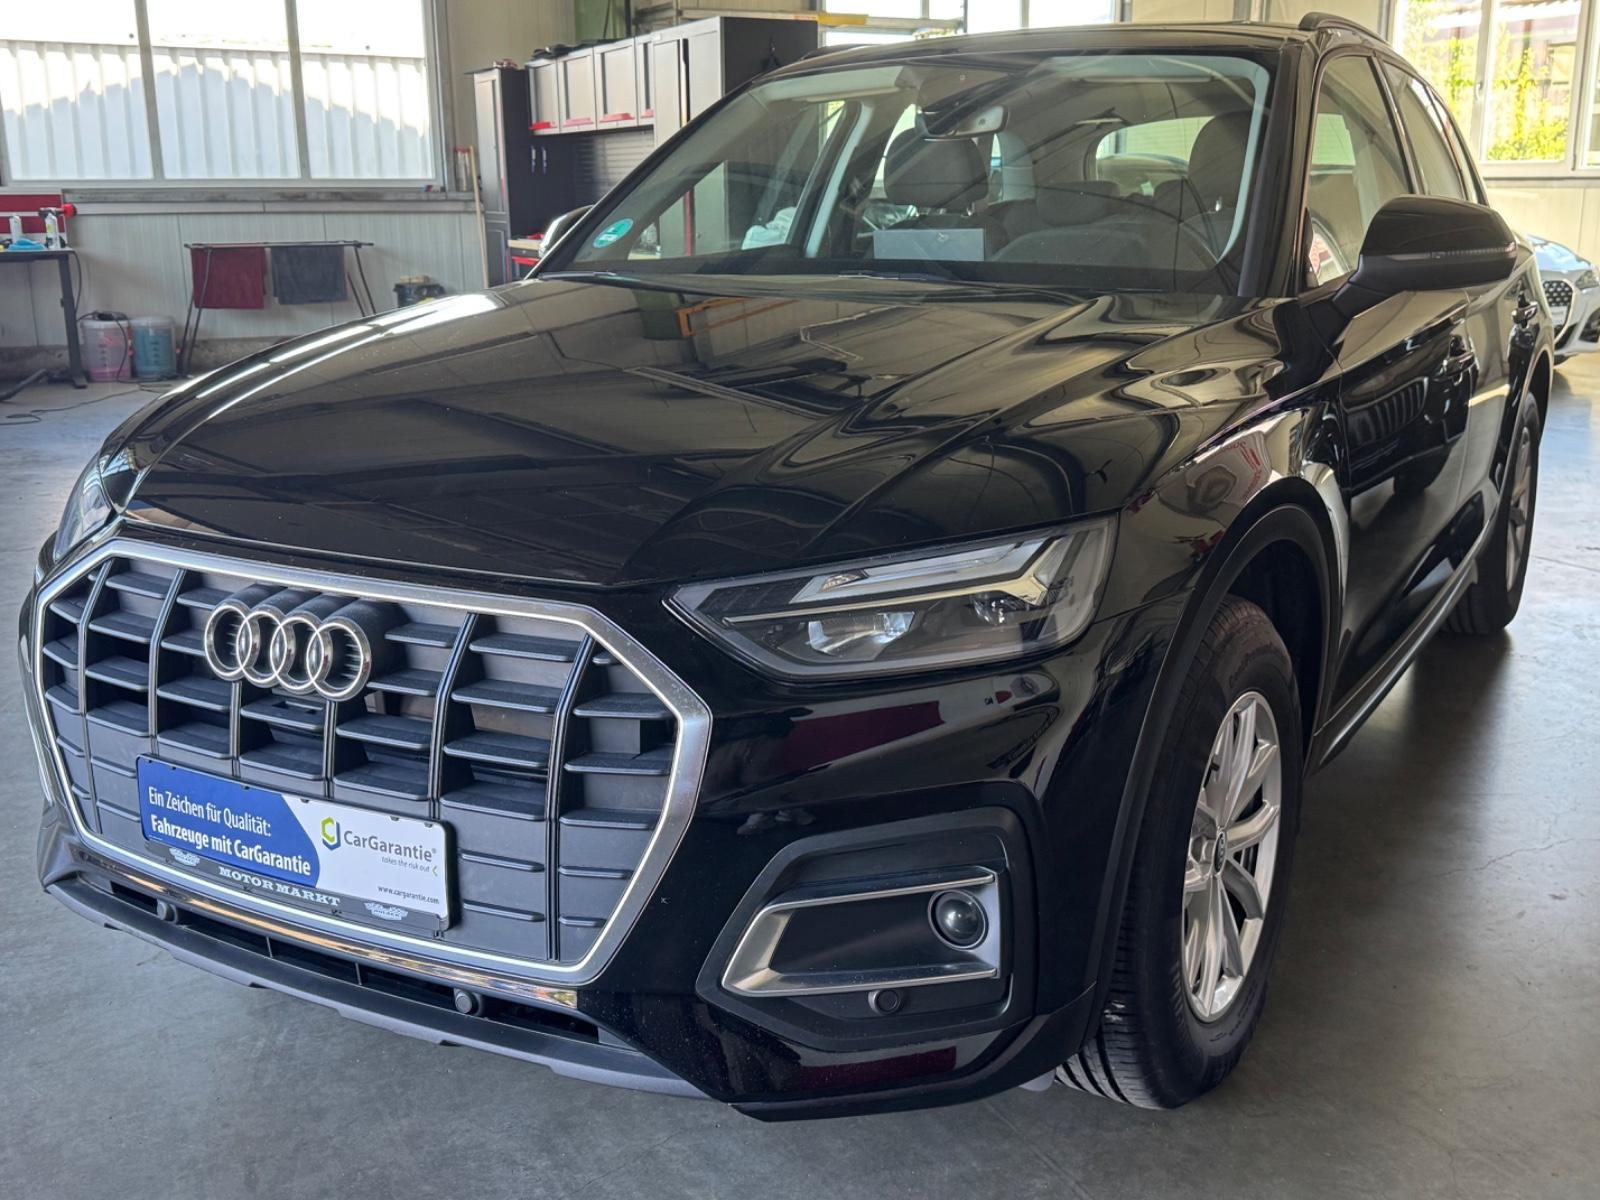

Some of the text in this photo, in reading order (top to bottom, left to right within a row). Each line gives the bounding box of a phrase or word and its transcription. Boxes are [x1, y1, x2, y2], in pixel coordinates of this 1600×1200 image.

[148, 786, 272, 837] Ein Zeichen für Qualität:
[150, 814, 209, 850] Fahrzeuge
[211, 835, 232, 856] mit
[234, 839, 311, 876] CarGarantie
